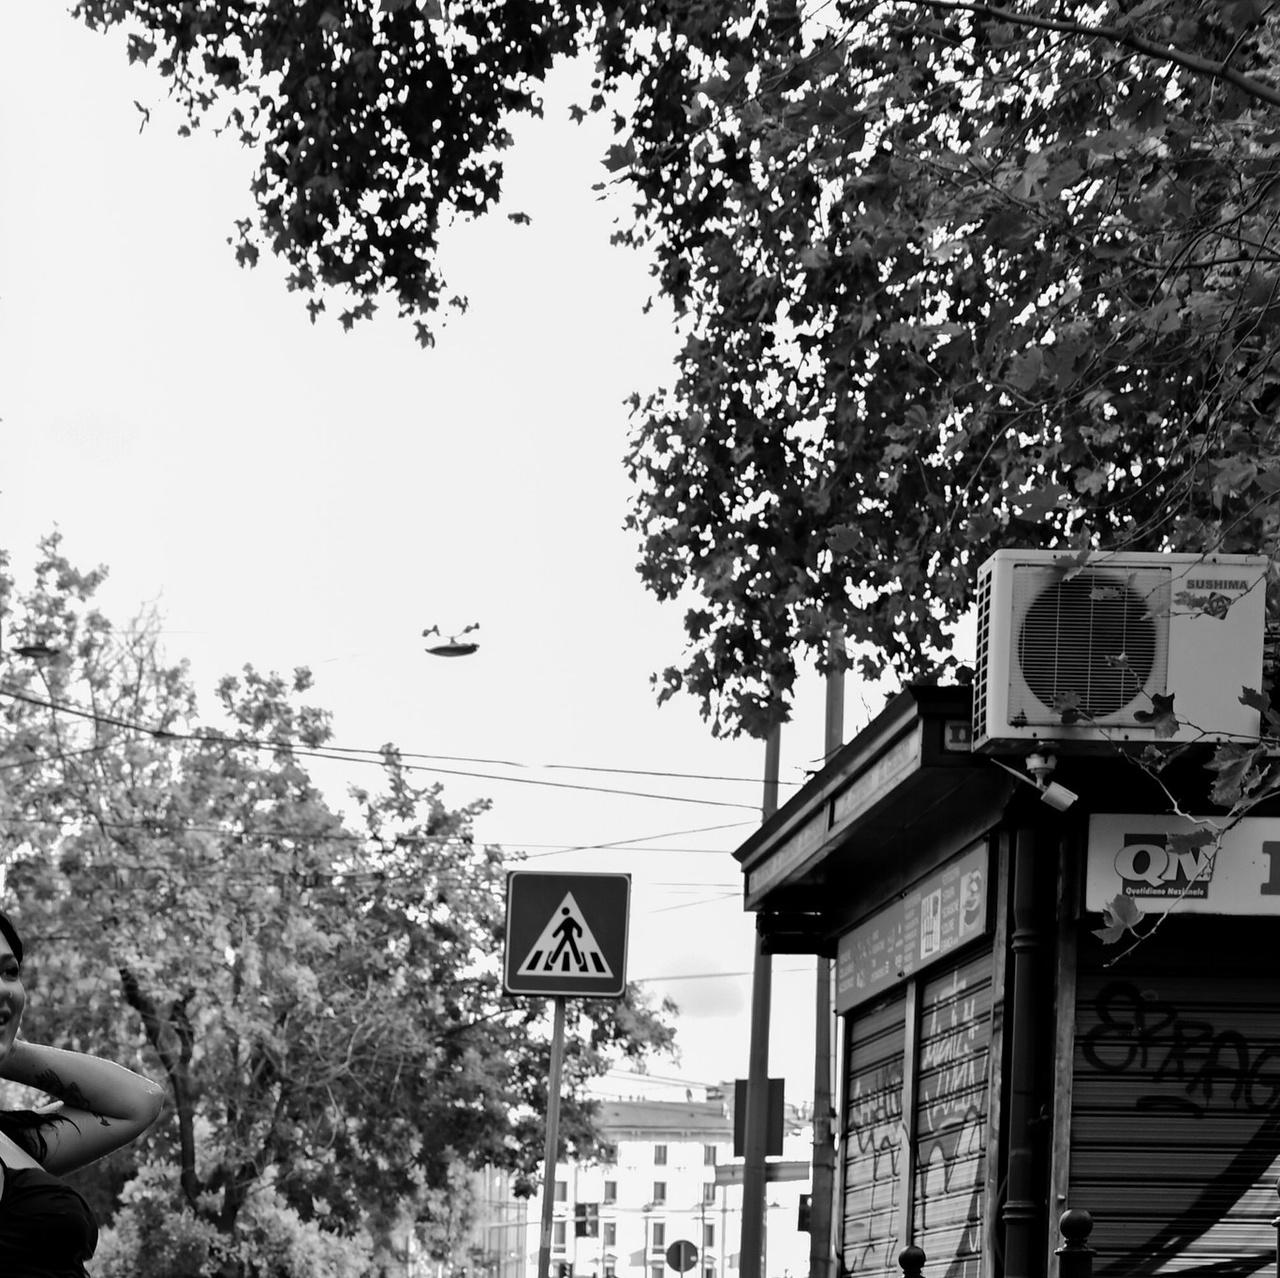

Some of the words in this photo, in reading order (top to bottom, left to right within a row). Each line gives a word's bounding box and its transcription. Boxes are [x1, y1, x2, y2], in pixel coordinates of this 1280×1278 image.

[1186, 579, 1248, 589] SUSHIMA
[1114, 843, 1219, 887] QN
[1125, 886, 1166, 896] Quotidiano
